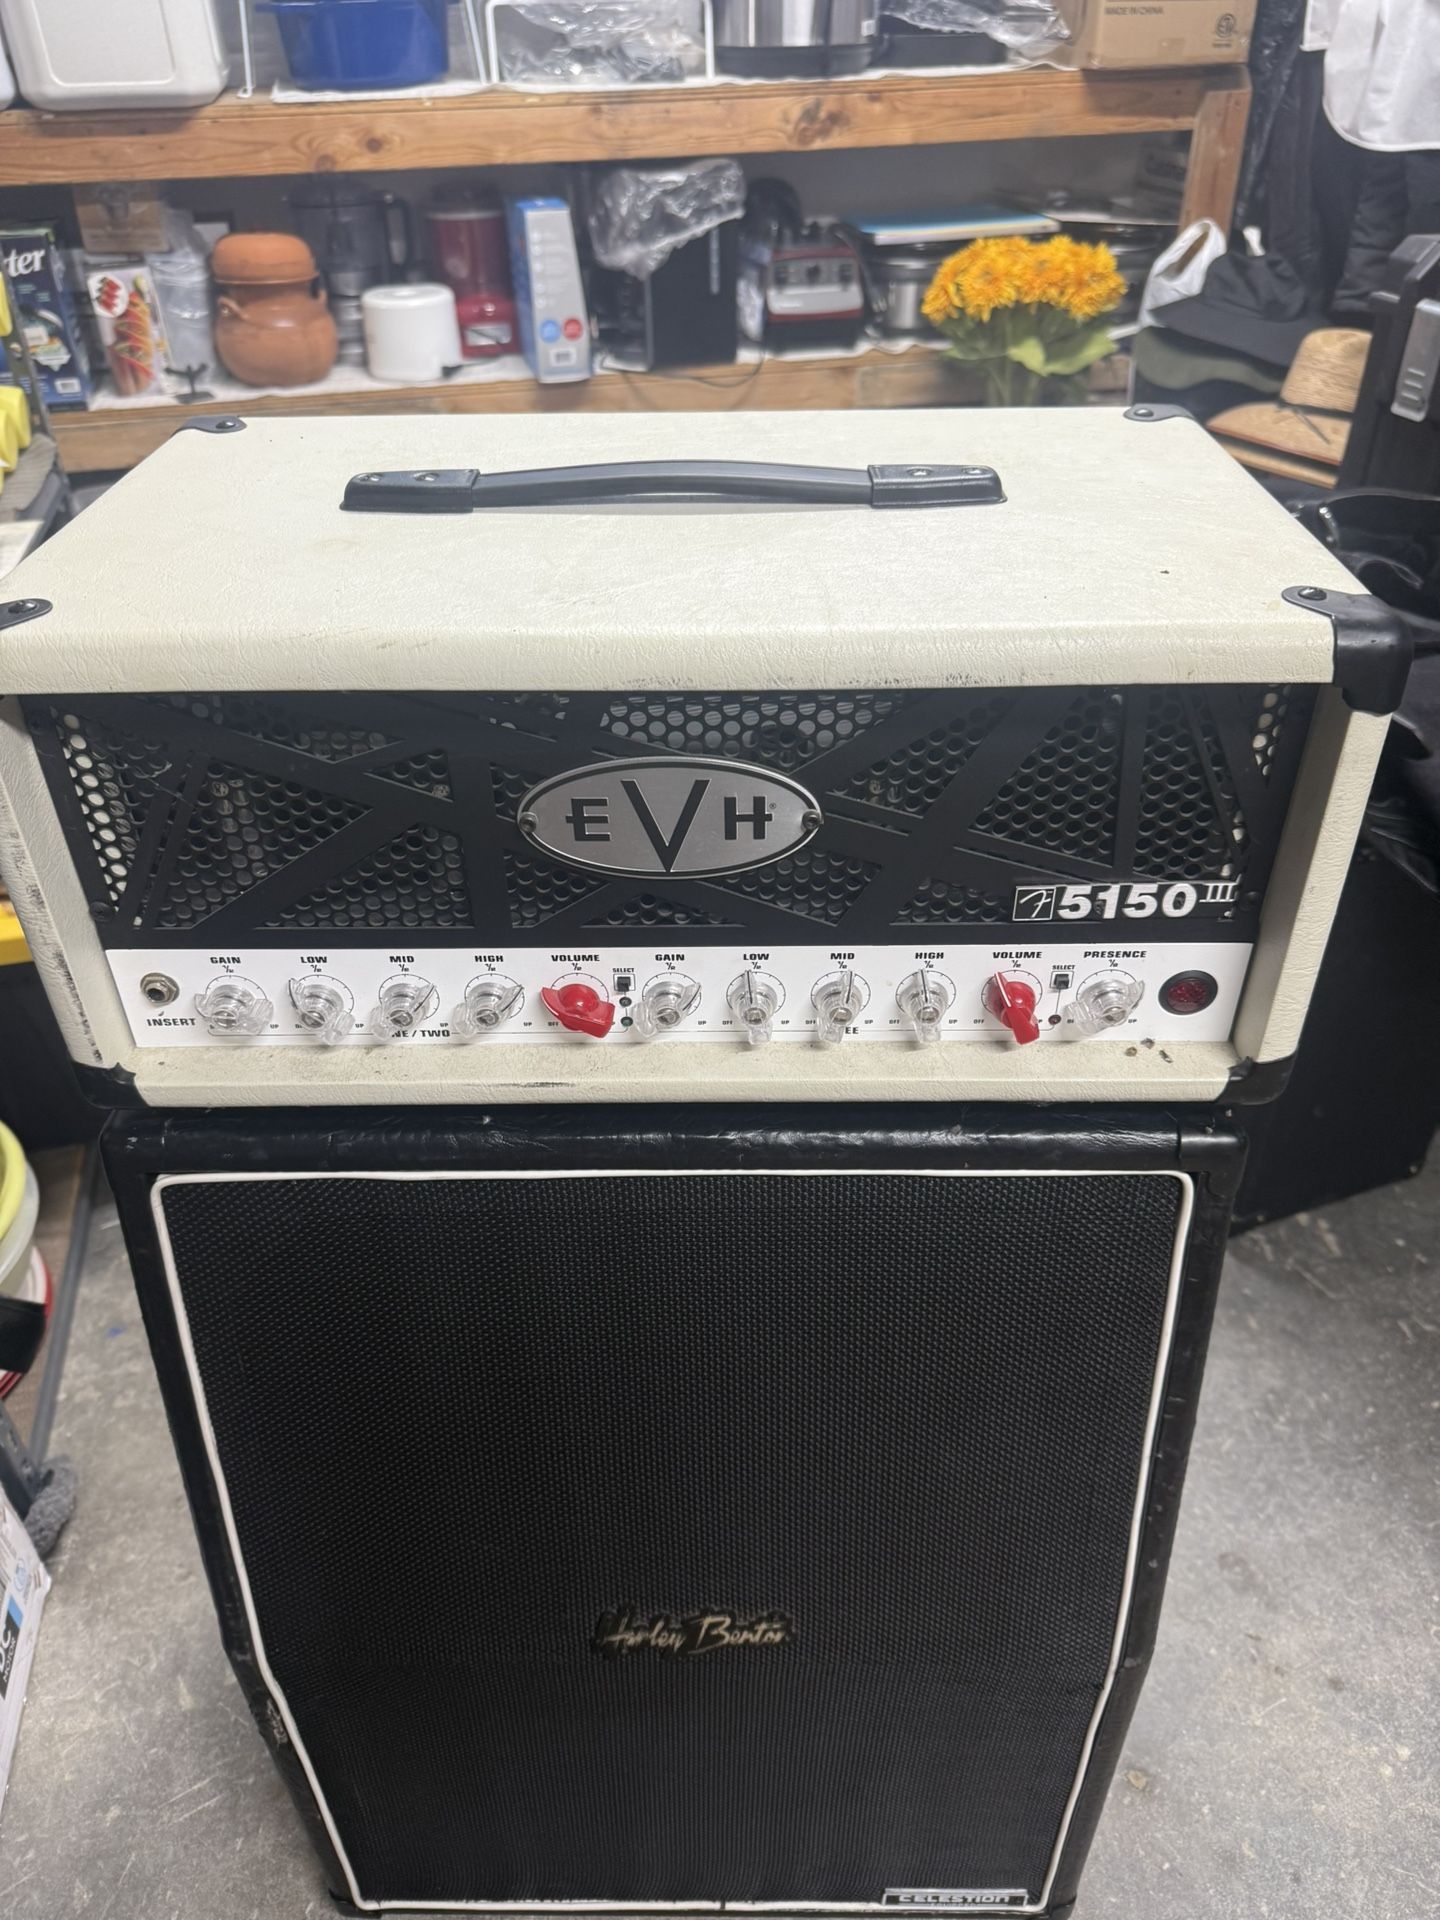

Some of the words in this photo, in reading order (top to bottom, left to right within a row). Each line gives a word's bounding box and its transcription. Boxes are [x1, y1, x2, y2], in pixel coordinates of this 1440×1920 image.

[565, 778, 773, 873] EVH
[1057, 883, 1197, 920] 5150
[389, 955, 415, 963] MID
[474, 955, 504, 963] HIGH
[550, 954, 601, 962] VOLUME
[654, 953, 685, 962] GAIN
[742, 953, 770, 961] LOW
[830, 952, 855, 960] MID
[914, 951, 945, 960] HIGH
[992, 951, 1043, 959] VOLUME
[1083, 950, 1147, 959] PRESENCE
[209, 956, 242, 965] GAIN
[299, 955, 328, 964] LOW
[146, 1017, 196, 1027] INSERT
[412, 1030, 417, 1038] /
[900, 1894, 1009, 1903] CELESTION
